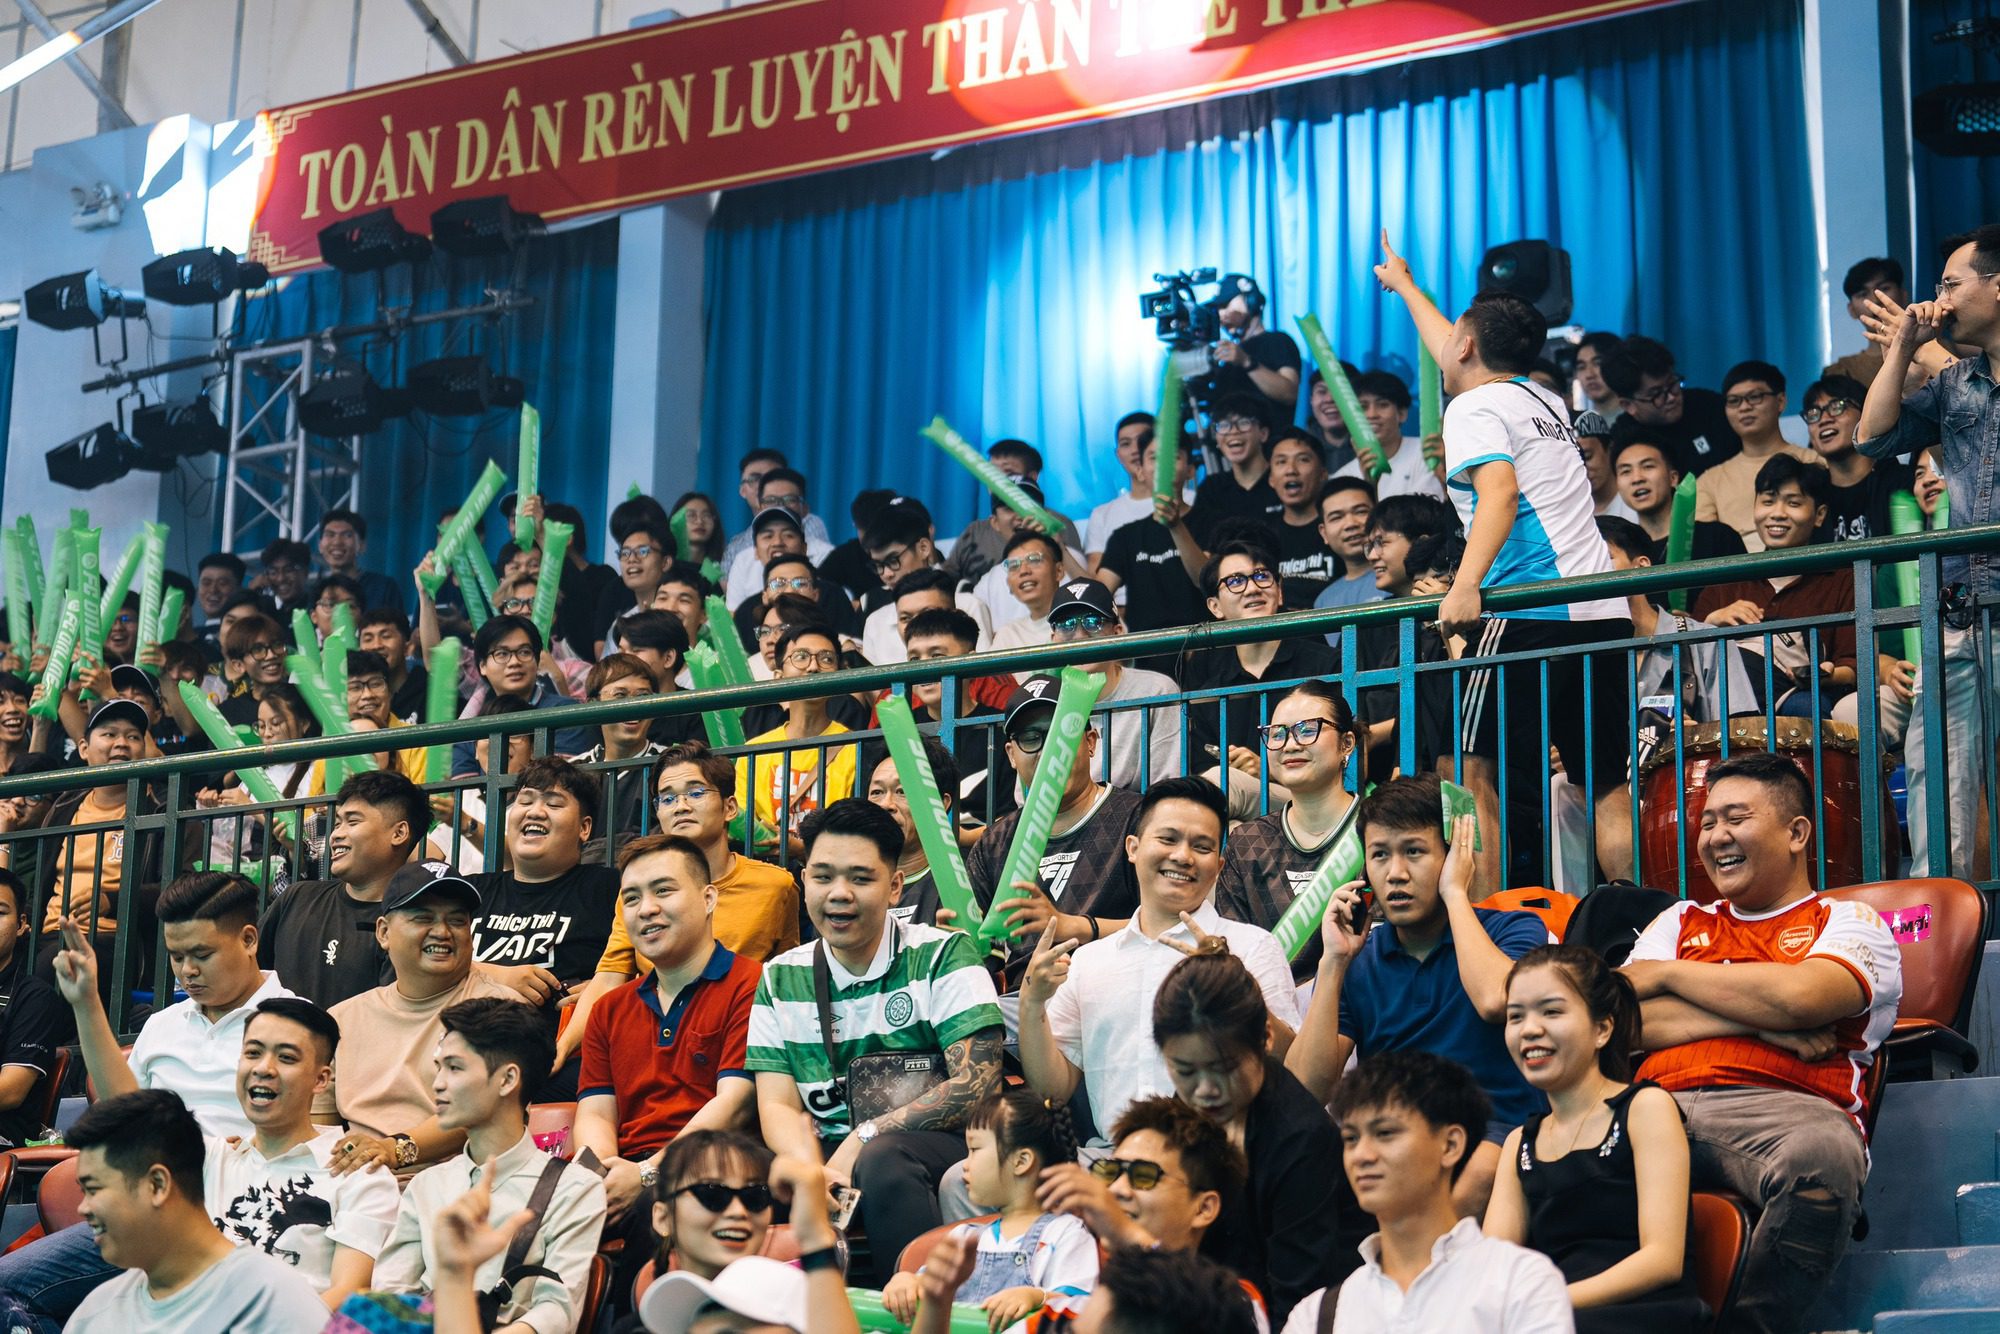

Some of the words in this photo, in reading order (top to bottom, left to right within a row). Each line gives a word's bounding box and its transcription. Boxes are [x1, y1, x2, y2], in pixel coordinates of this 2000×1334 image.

[301, 117, 441, 219] TOÀN
[451, 88, 567, 189] DÂN
[578, 63, 697, 163] RÈN
[707, 30, 907, 138] LUYỆN
[82, 570, 98, 599] FC
[62, 611, 77, 634] FC
[45, 630, 72, 690] ONLINE
[1046, 735, 1074, 786] FC
[530, 911, 557, 929] THÌ
[472, 932, 554, 962] VAR
